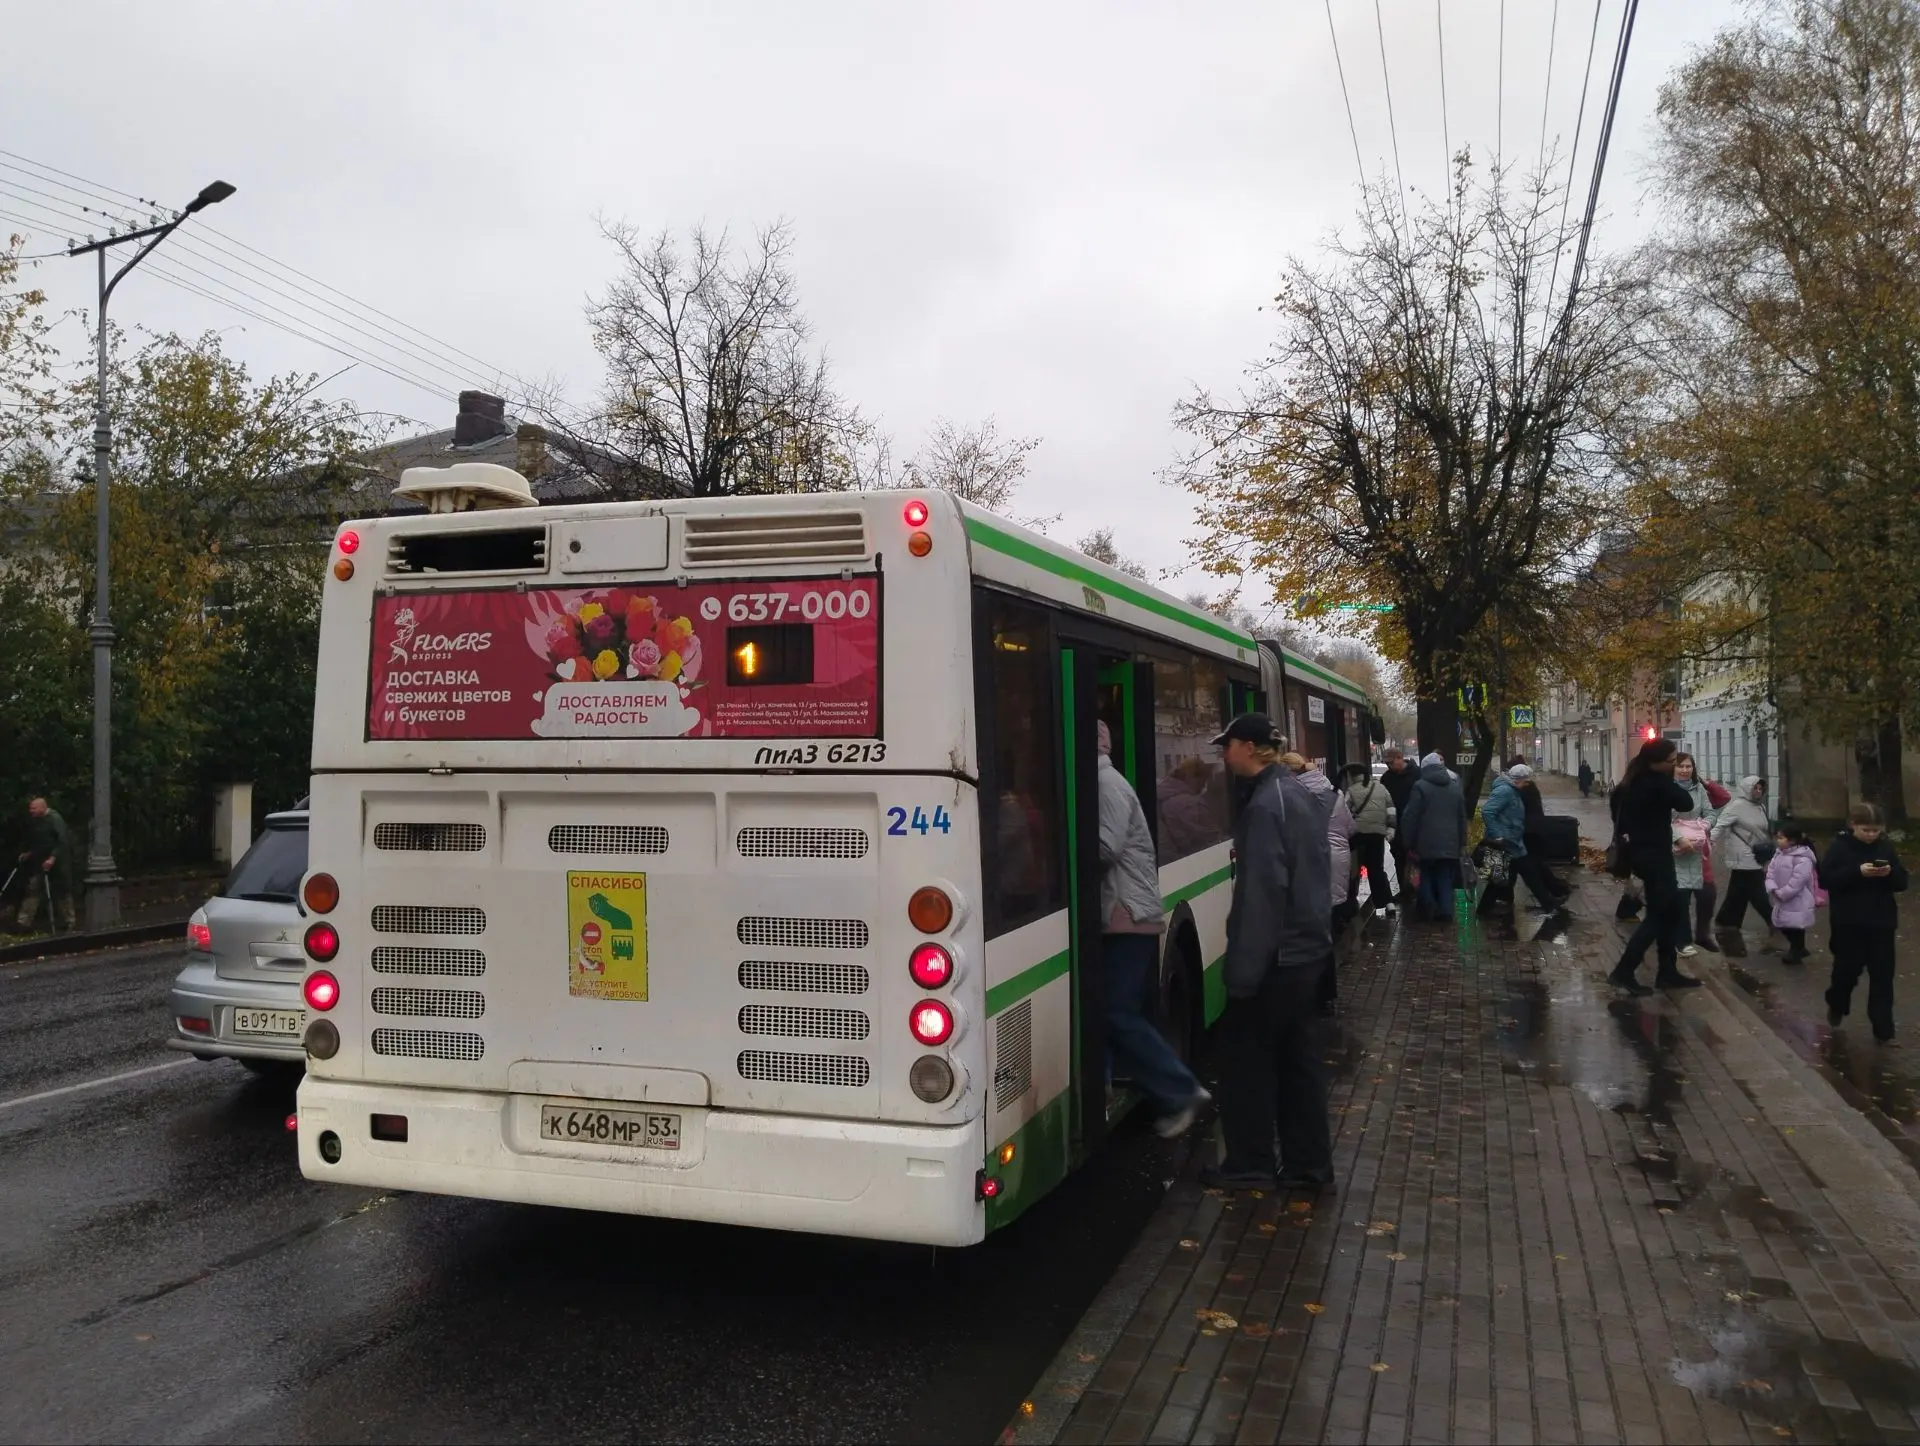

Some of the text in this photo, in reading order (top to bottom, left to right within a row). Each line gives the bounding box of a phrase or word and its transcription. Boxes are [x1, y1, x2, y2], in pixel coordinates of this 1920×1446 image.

[727, 589, 871, 621] 637-000
[413, 632, 493, 652] FLOWERS
[412, 652, 452, 661] express
[738, 642, 755, 674] 1
[386, 669, 480, 689] ДОСТАВКА
[385, 690, 511, 704] свежих цветов
[558, 694, 668, 710] ДОСТАВЛЯЕМ
[384, 707, 466, 725] и букетов
[574, 711, 649, 726] РАДОСТЬ
[827, 743, 887, 763] 6213
[887, 805, 951, 835] 244
[571, 876, 643, 890] СПАСИБО
[589, 980, 628, 989] УСТУПИТЕ
[648, 1116, 671, 1137] 53
[647, 1137, 664, 1146] RUS
